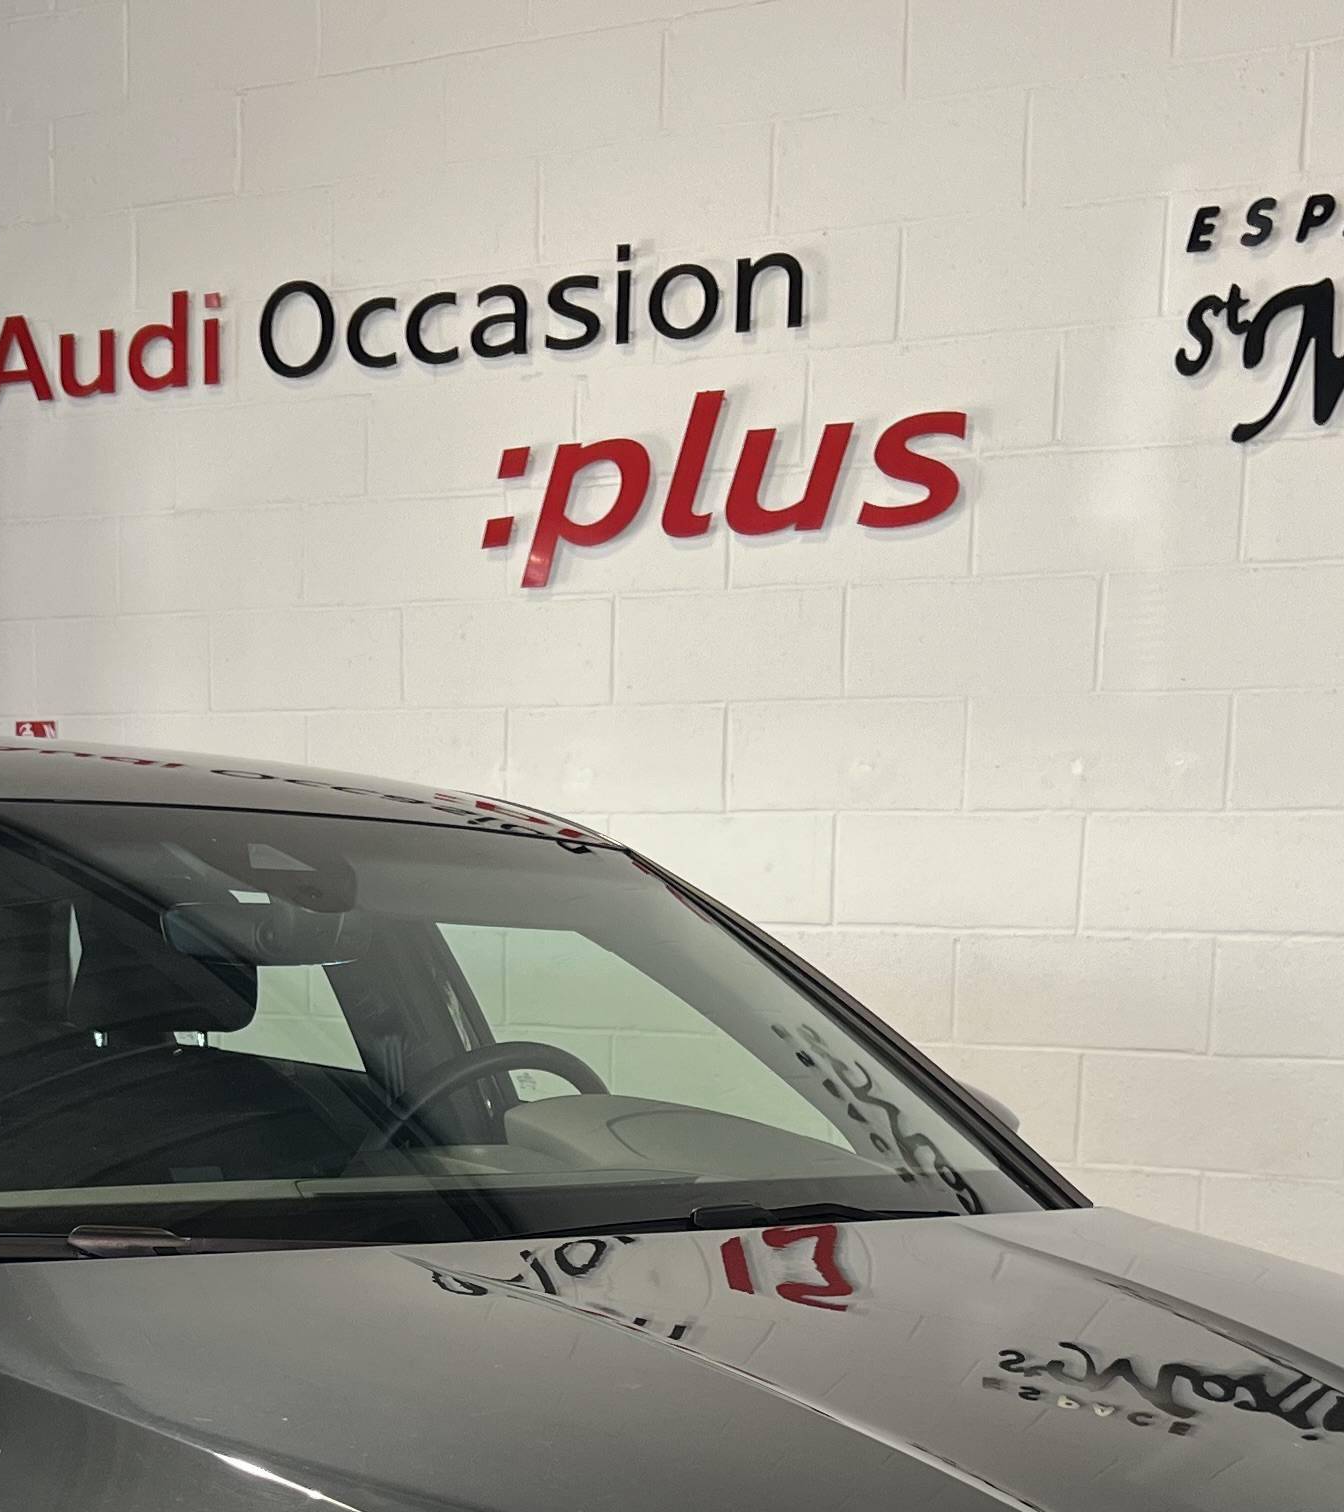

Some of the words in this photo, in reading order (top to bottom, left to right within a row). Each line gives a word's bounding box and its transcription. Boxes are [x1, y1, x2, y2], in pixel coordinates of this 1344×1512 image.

[258, 244, 804, 380] Occasion
[1174, 282, 1251, 377] St
[481, 390, 968, 588] :plus
